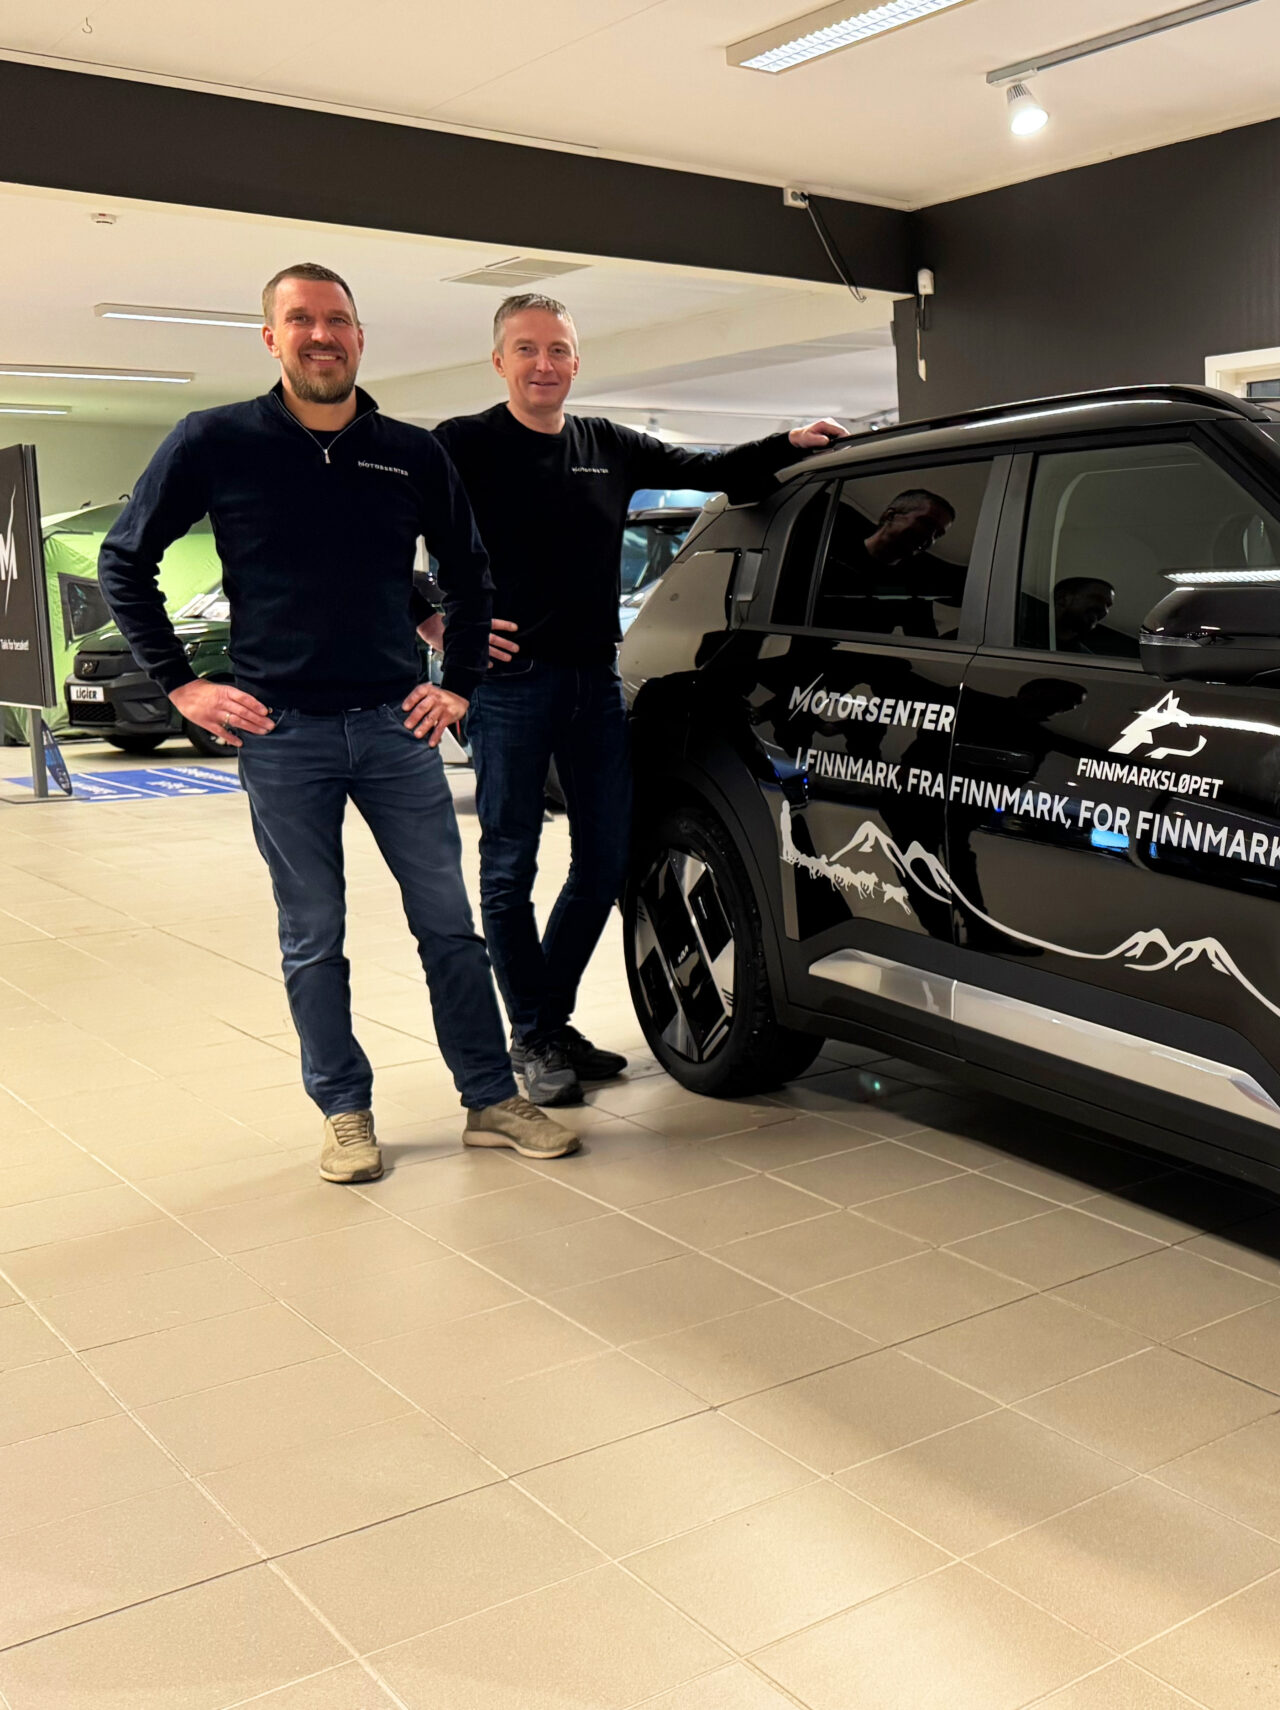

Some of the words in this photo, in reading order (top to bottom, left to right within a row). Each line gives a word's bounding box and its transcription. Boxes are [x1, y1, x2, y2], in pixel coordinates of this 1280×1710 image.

[789, 673, 955, 732] MOTORSENTER
[794, 747, 803, 770] I
[804, 748, 902, 794] FINNMARK,
[907, 768, 946, 800] FRA
[949, 775, 1072, 829] FINNMARK,
[1077, 799, 1130, 836] FOR
[1076, 757, 1224, 800] FINNMARKSLØPET
